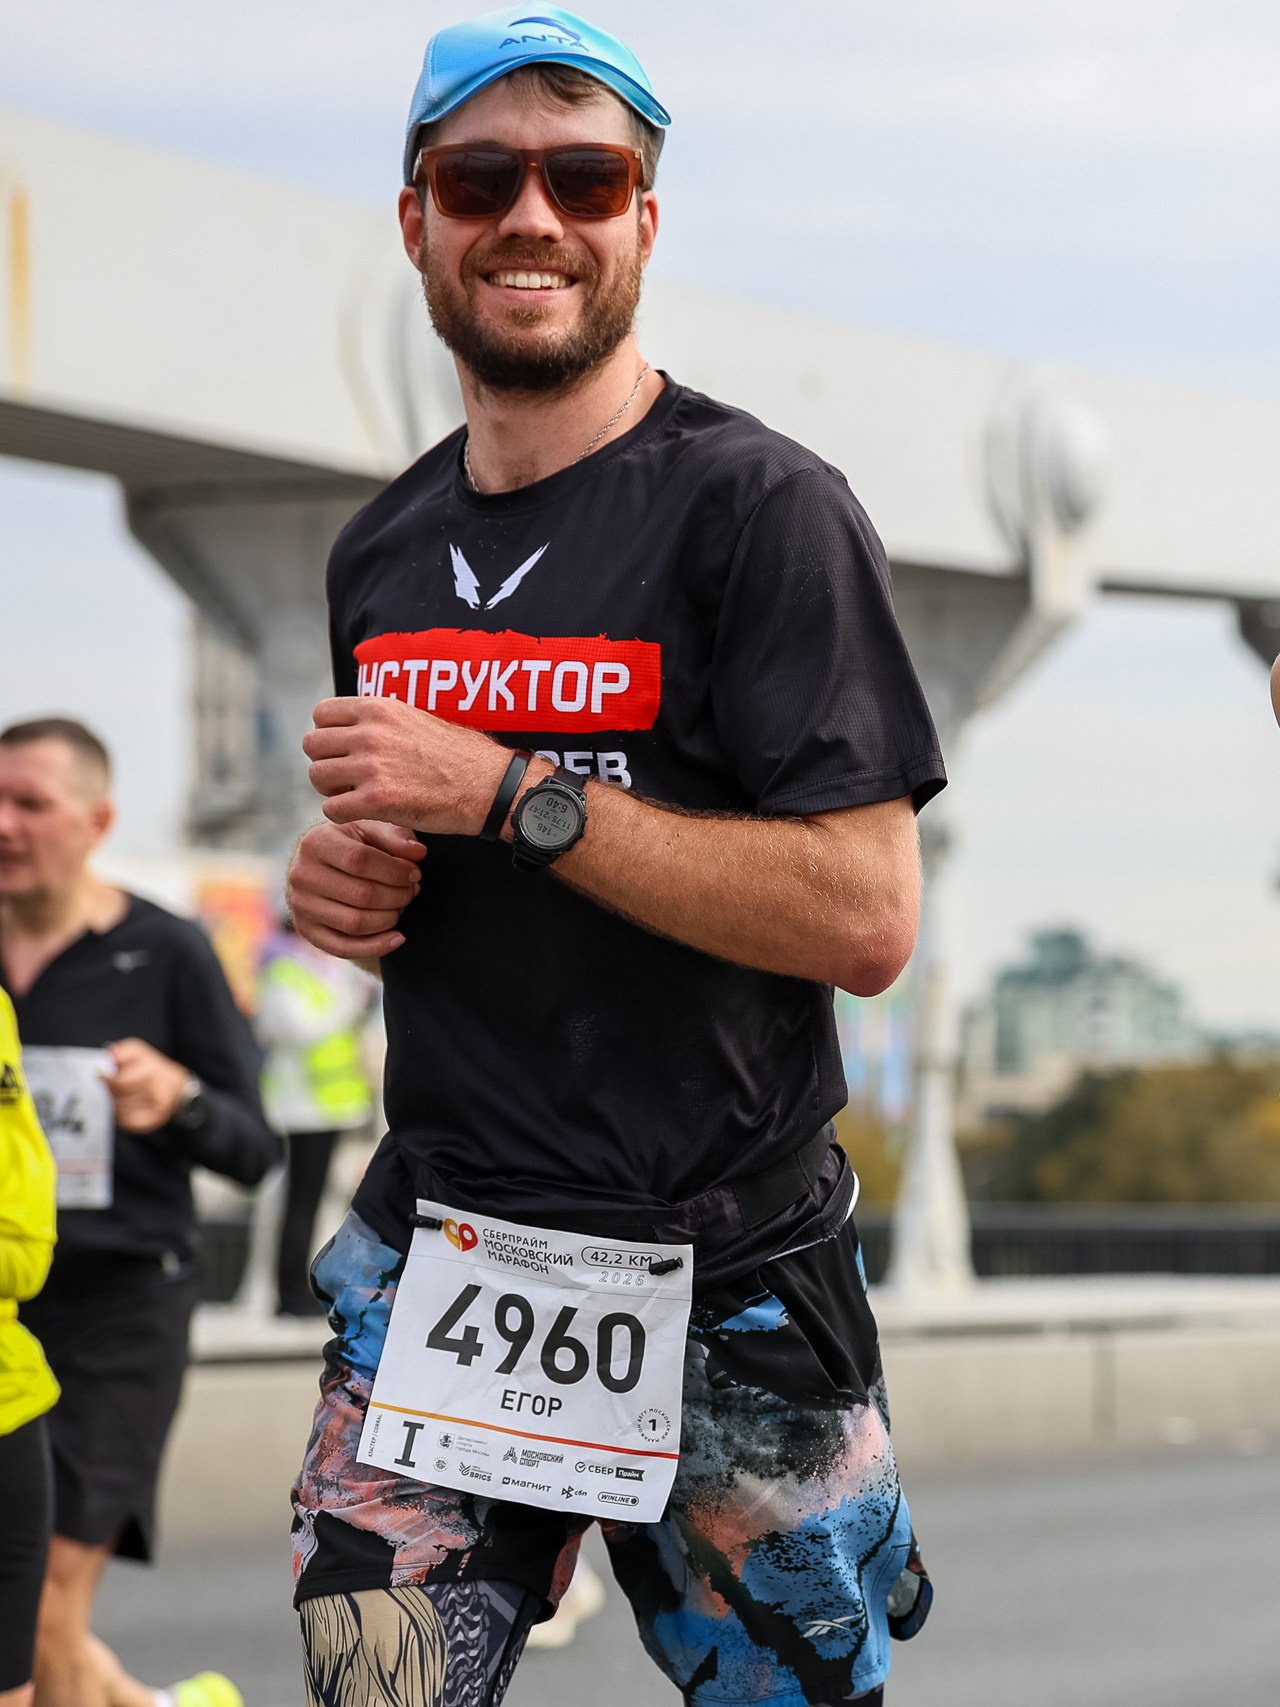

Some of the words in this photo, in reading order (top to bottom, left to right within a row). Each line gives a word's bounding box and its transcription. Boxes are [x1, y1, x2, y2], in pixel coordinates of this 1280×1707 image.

[499, 35, 590, 52] ANTA
[357, 659, 630, 713] НСТРУКТОР
[546, 797, 568, 814] 6:40
[482, 1228, 548, 1249] СБЕРПРАЙМ
[484, 1239, 573, 1266] МОСКОВСКИЙ
[590, 1251, 622, 1265] 42,2
[487, 1250, 549, 1274] МАРАФОН
[598, 1270, 645, 1287] 2026
[425, 1283, 646, 1394] 4960
[500, 1388, 562, 1418] ЕГОР
[519, 1457, 540, 1468] СПОРТ
[521, 1449, 564, 1464] МОСКОВСКИЙ
[469, 1471, 492, 1482] BRICS
[588, 1465, 614, 1476] СБЕР
[600, 1494, 630, 1503] WINLINE
